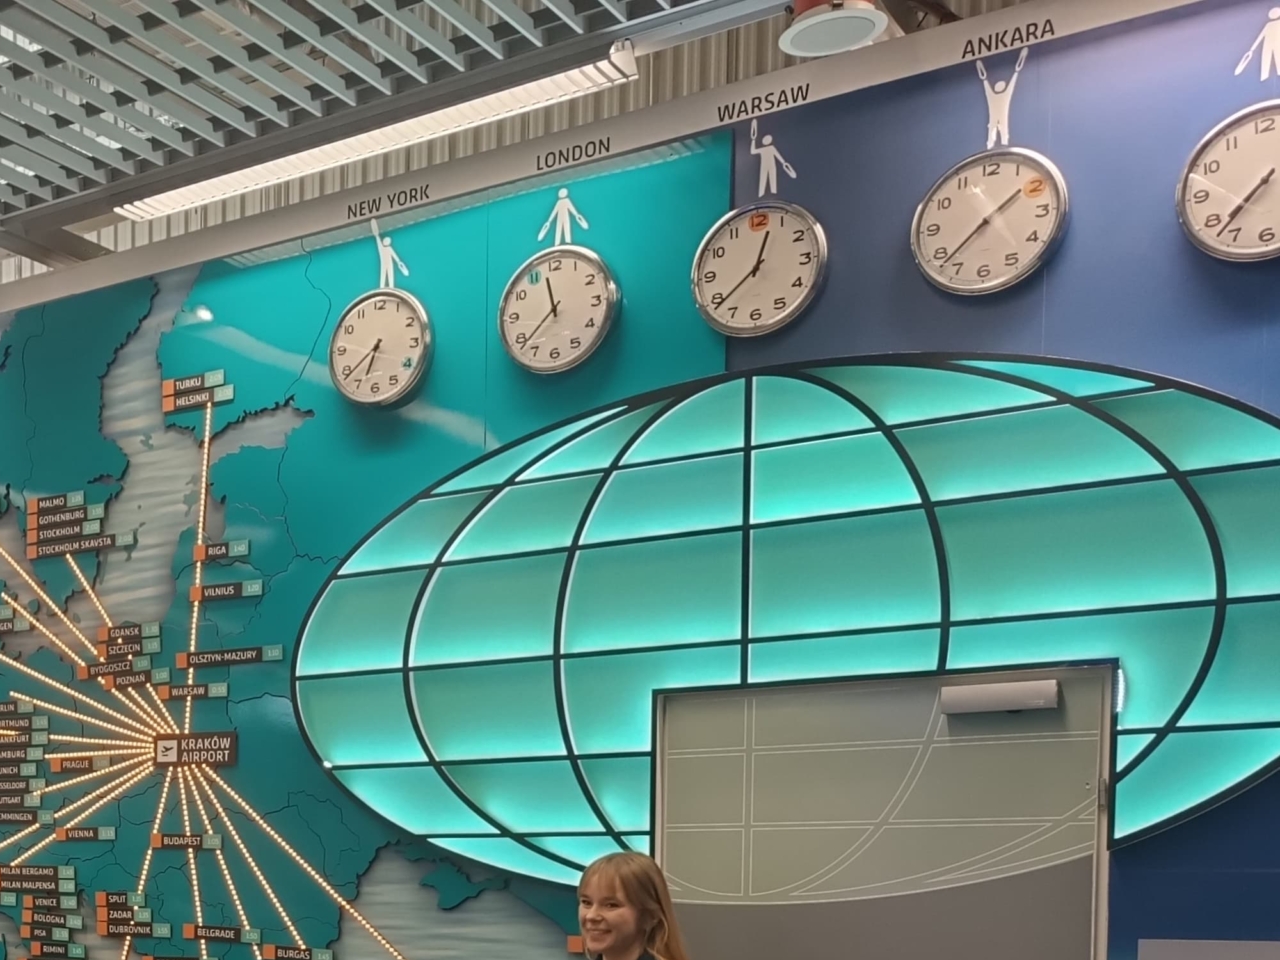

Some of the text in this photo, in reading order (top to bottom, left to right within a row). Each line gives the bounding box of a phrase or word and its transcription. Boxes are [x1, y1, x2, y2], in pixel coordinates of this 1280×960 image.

[962, 19, 1055, 59] ANKARA
[718, 83, 810, 122] WARSAW
[536, 137, 611, 171] LONDON
[347, 184, 430, 219] NEW YORK
[176, 377, 202, 390] TURKU
[176, 392, 210, 407] HELSINKI
[39, 497, 65, 509] MALMO
[39, 510, 84, 525] GOTHENBURG
[39, 526, 80, 540] STOCKHOLM
[38, 538, 112, 555] STOCKHOLM SKAVSTA
[208, 547, 227, 556] RIGA
[204, 586, 235, 596] VILNIUS
[110, 627, 140, 638] GDANSK
[108, 644, 141, 655] SZCZECIN
[190, 650, 257, 664] OLSZTYN-MAZURY
[90, 662, 131, 675] BYDGOSZCZ
[116, 674, 146, 685] POZNAŃ
[171, 686, 205, 696] WARSAW
[181, 736, 231, 750] KRAKÓW
[181, 750, 230, 763] AIRPORT
[62, 759, 89, 768] PRAGUE
[163, 836, 201, 846] BUDAPEST
[0, 867, 54, 876] MILAN BERGAMO
[1, 881, 55, 890] MILAN MALPENSA
[35, 898, 57, 907] VENICE
[108, 895, 126, 904] SPLIT
[33, 913, 65, 925] BOLOGNA
[109, 910, 132, 919] ZADAR
[33, 929, 47, 937] PISA
[109, 925, 151, 935] DUBROVNIK
[197, 928, 235, 939] BELGRADE
[43, 946, 65, 954] RIMINI
[277, 949, 311, 960] BURGAS
